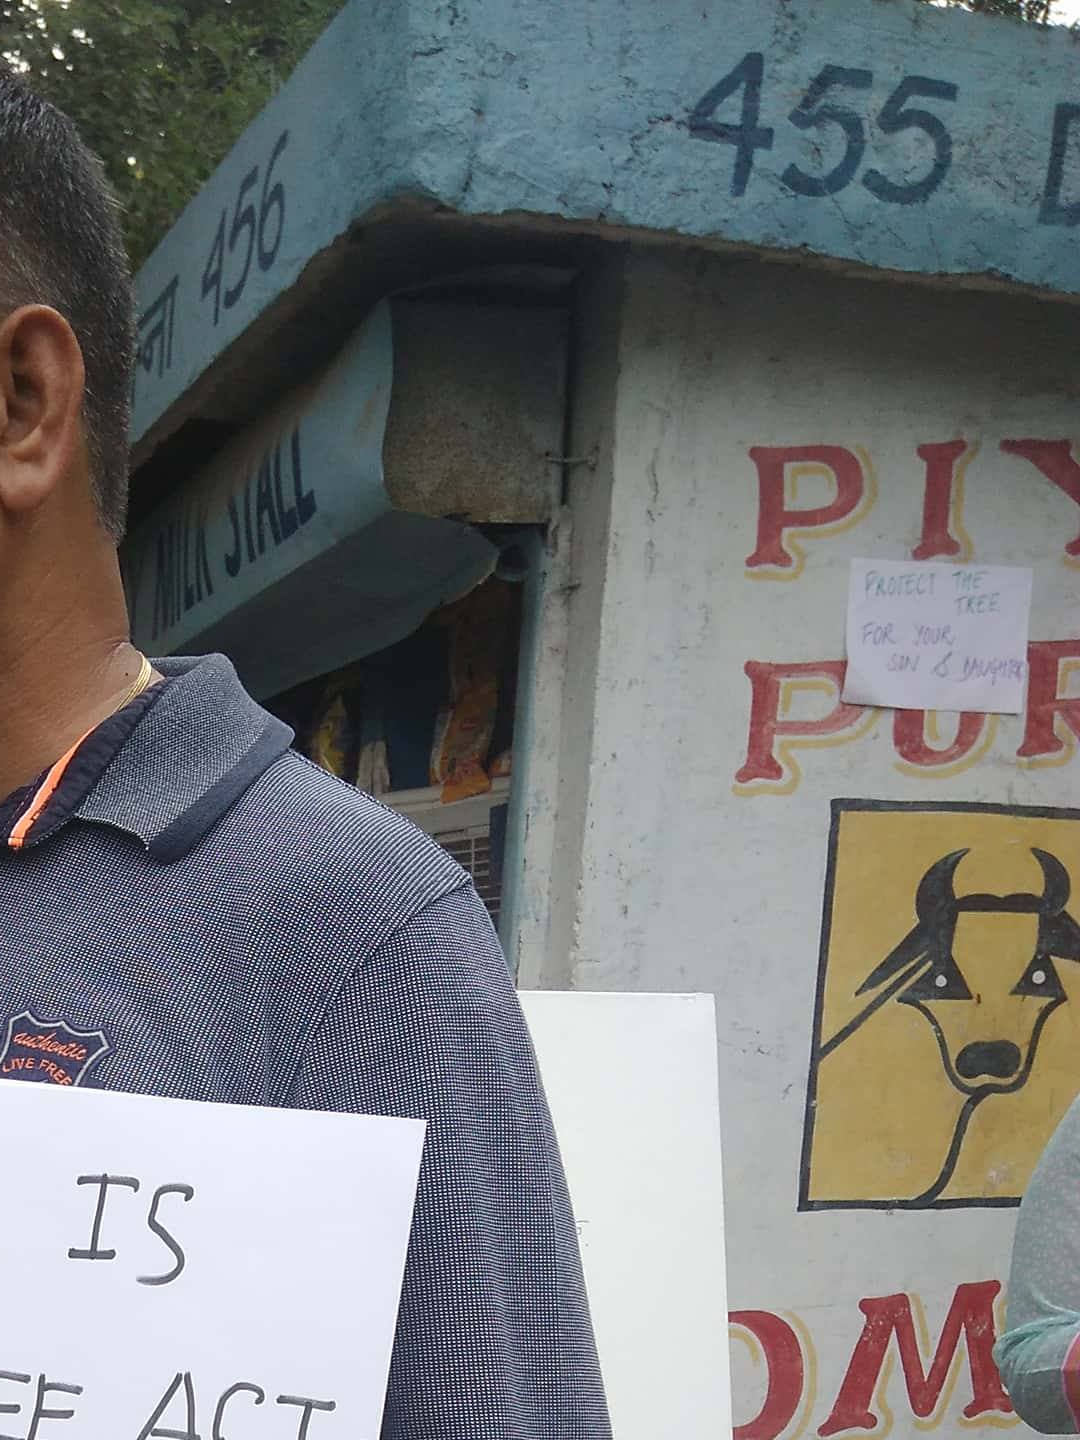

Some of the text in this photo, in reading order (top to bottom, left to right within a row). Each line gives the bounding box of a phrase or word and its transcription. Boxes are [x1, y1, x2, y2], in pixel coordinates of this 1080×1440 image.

[688, 51, 960, 204] 455
[201, 129, 289, 327] 456
[864, 570, 989, 598] PROTECT THE
[954, 592, 1001, 617] TREE
[862, 622, 956, 646] FOR YOUR
[887, 653, 921, 673] SON
[2, 1057, 73, 1087] LIVE FREE
[67, 1172, 195, 1287] IS
